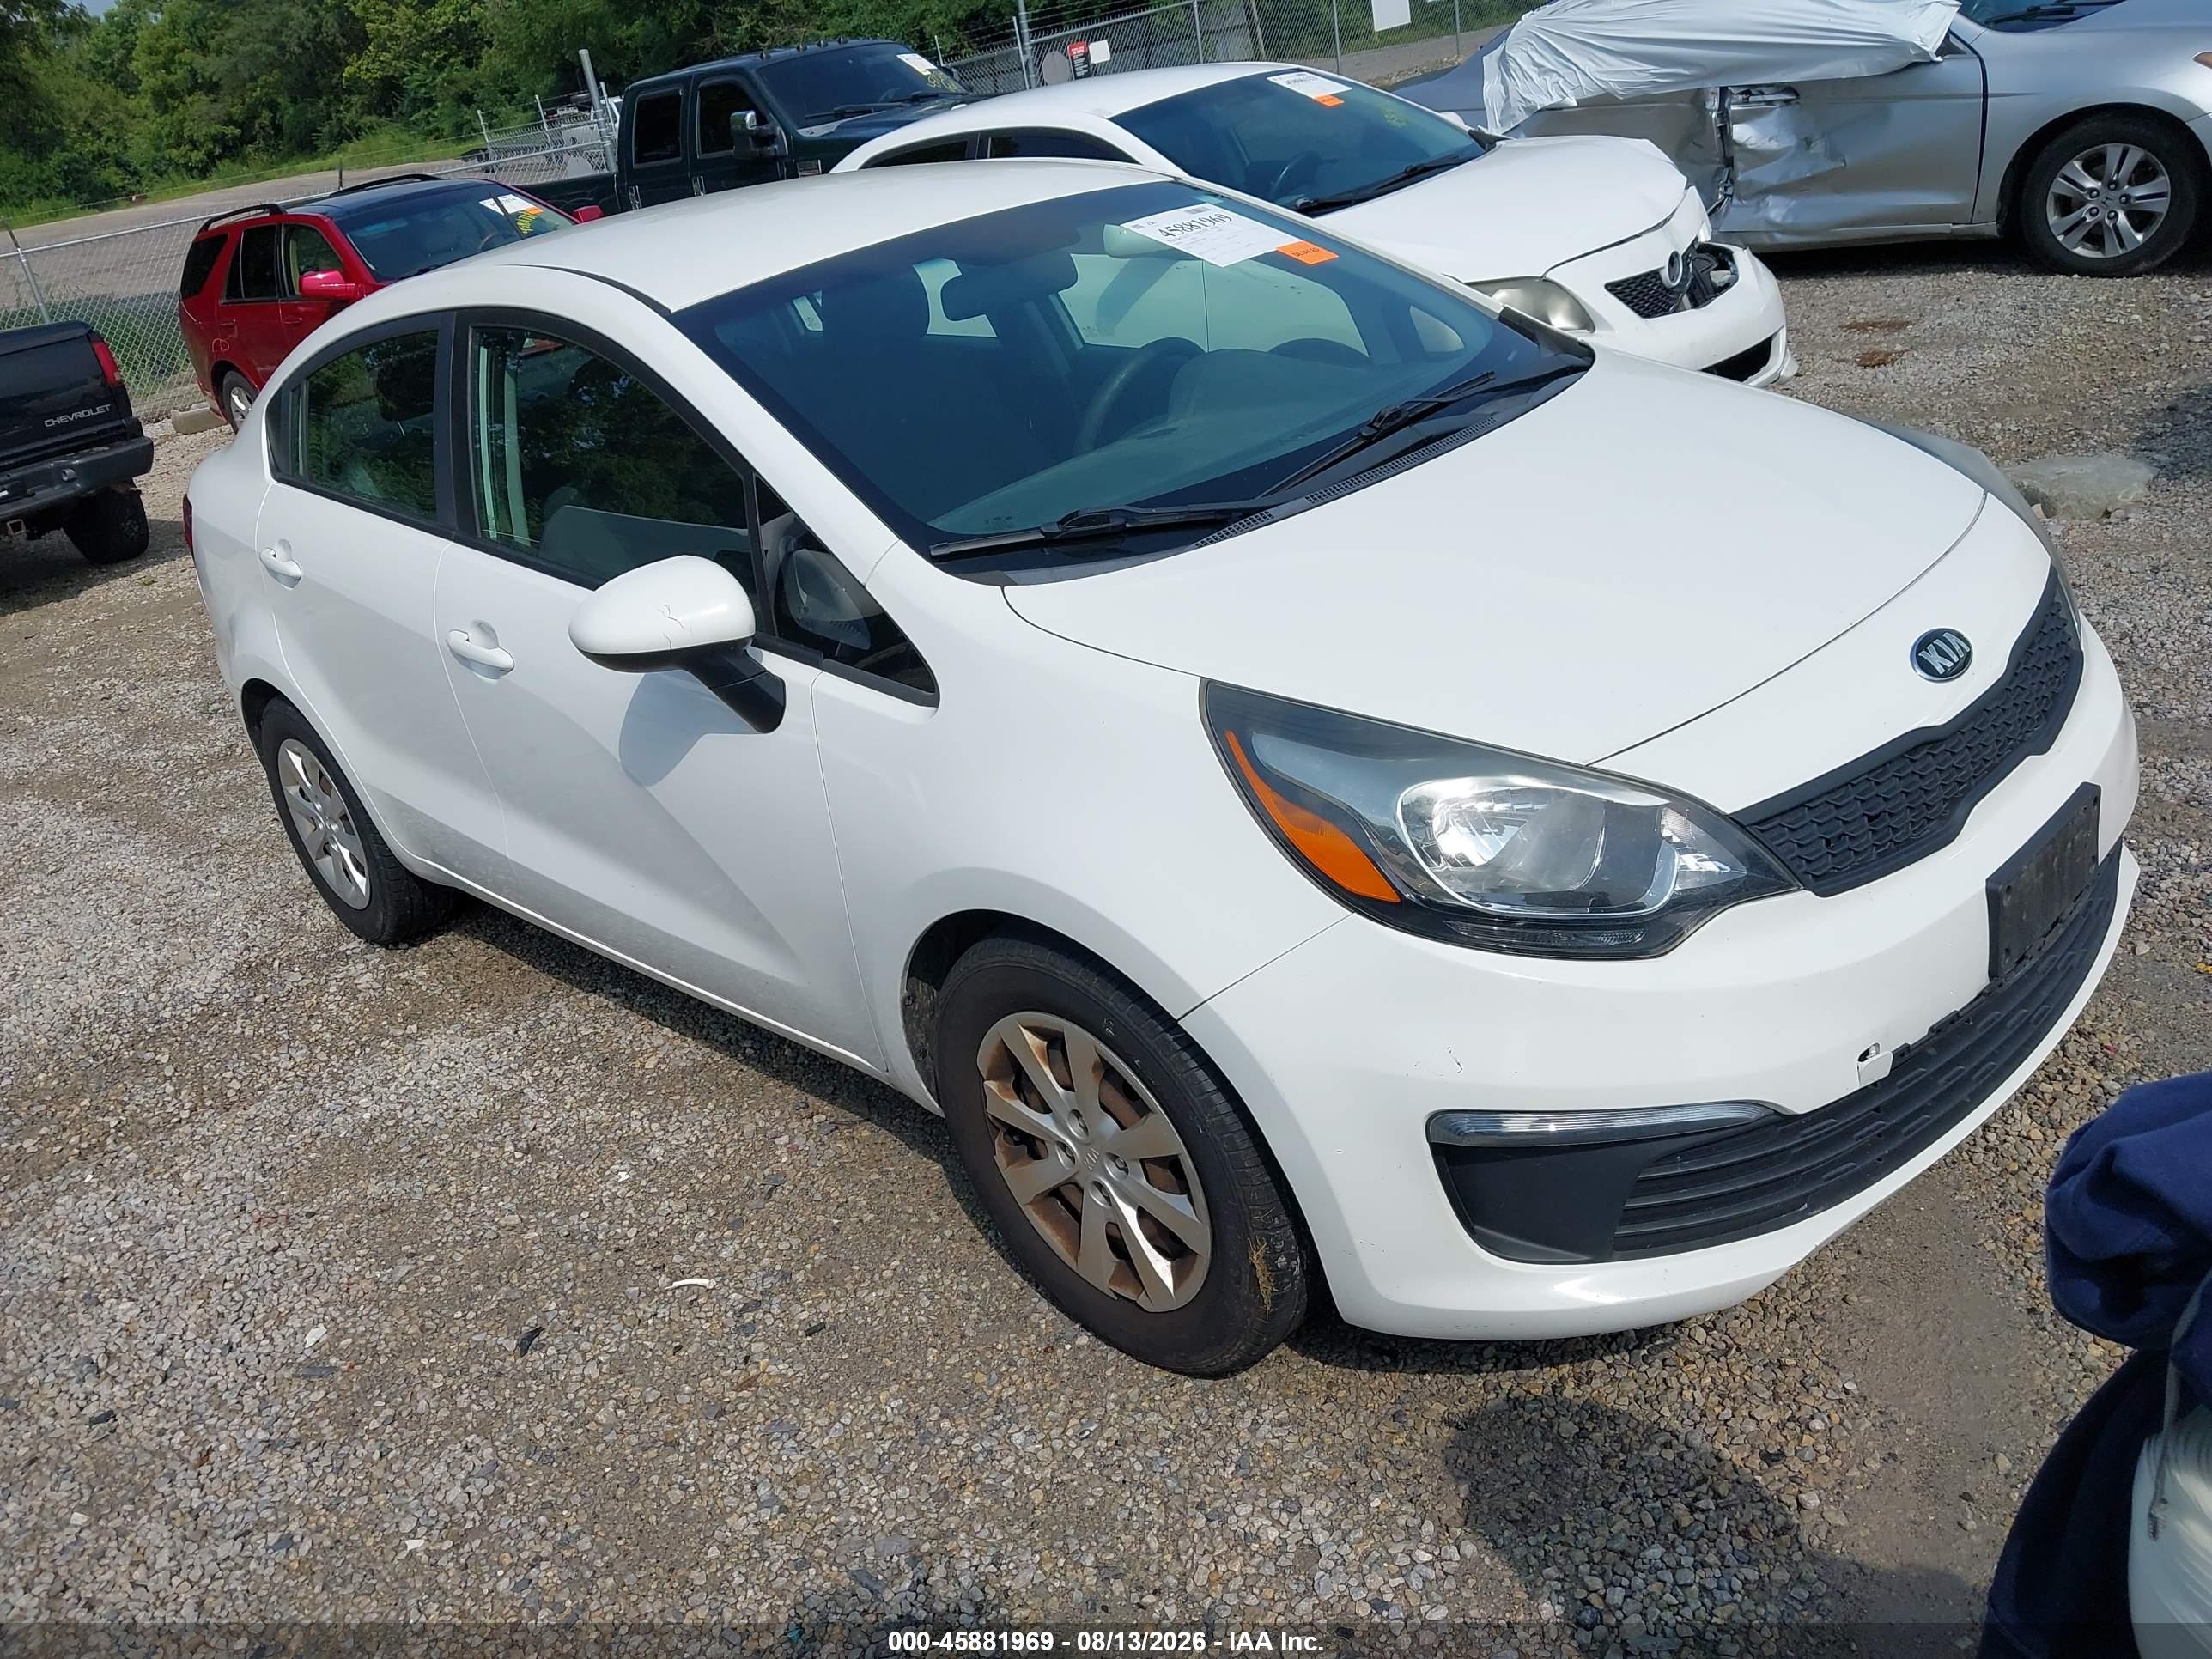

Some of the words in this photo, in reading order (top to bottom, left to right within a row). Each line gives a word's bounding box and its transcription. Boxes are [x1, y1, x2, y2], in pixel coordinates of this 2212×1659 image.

[1158, 213, 1233, 238] 45881969
[44, 404, 111, 427] CHEVROLET
[1917, 632, 1971, 675] KIA
